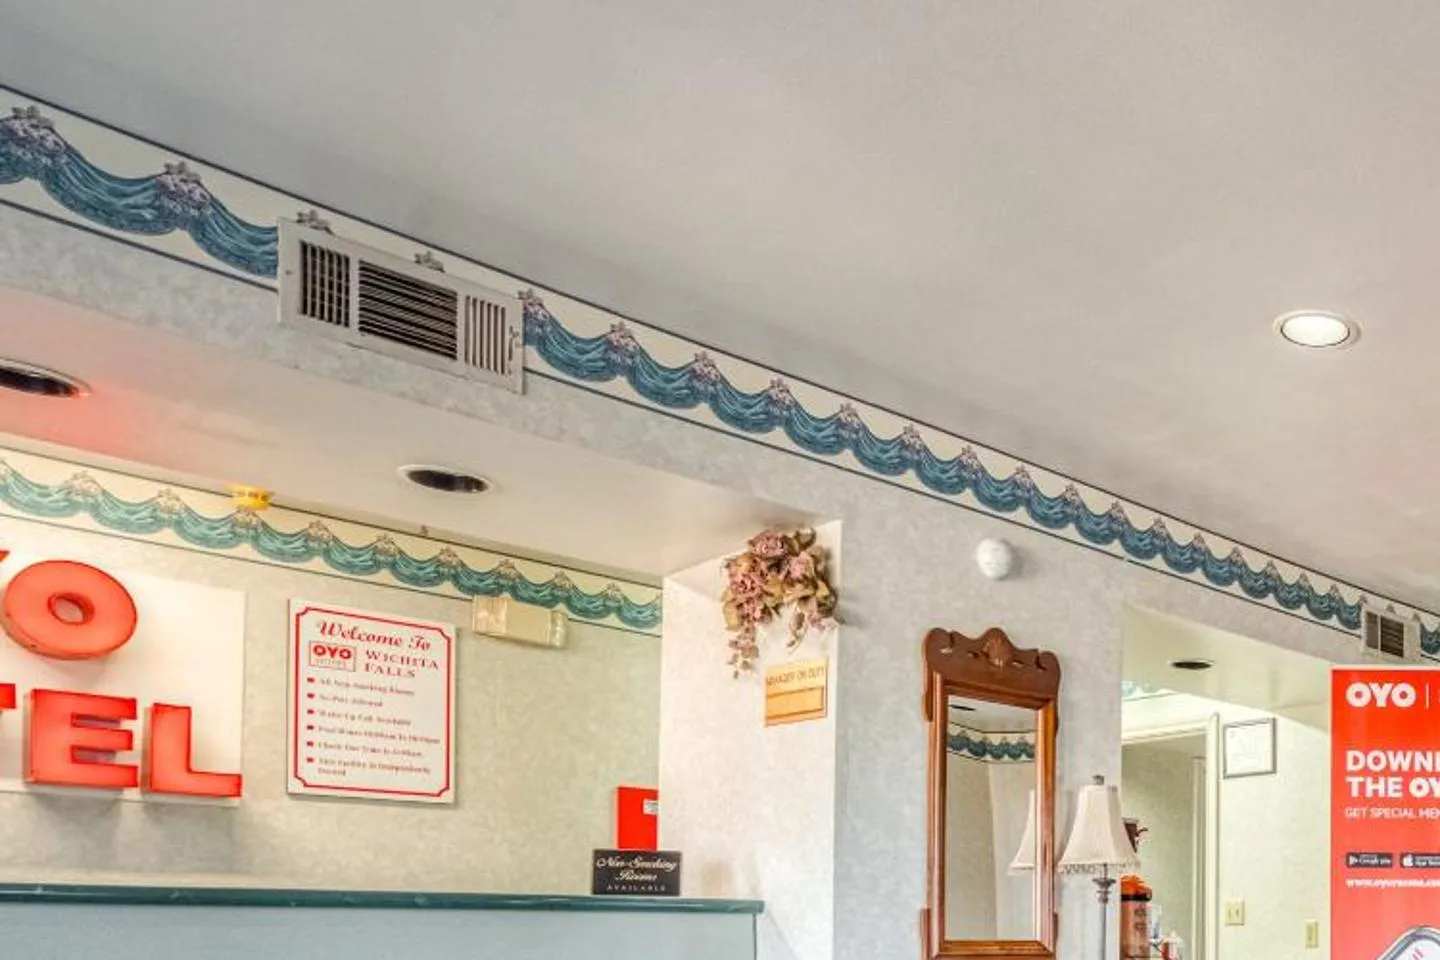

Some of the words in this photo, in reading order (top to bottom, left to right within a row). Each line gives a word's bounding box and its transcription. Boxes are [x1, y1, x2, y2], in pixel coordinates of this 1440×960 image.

[0, 550, 138, 660] O
[318, 620, 402, 647] Welcome
[408, 635, 431, 651] To
[313, 644, 352, 660] OYO
[365, 650, 440, 670] WICHITA
[364, 663, 416, 678] FALLS
[1346, 682, 1416, 708] OYO
[0, 683, 242, 798] EL
[1345, 776, 1403, 798] THE
[1345, 807, 1367, 818] GET
[1370, 808, 1416, 818] SPECIAL
